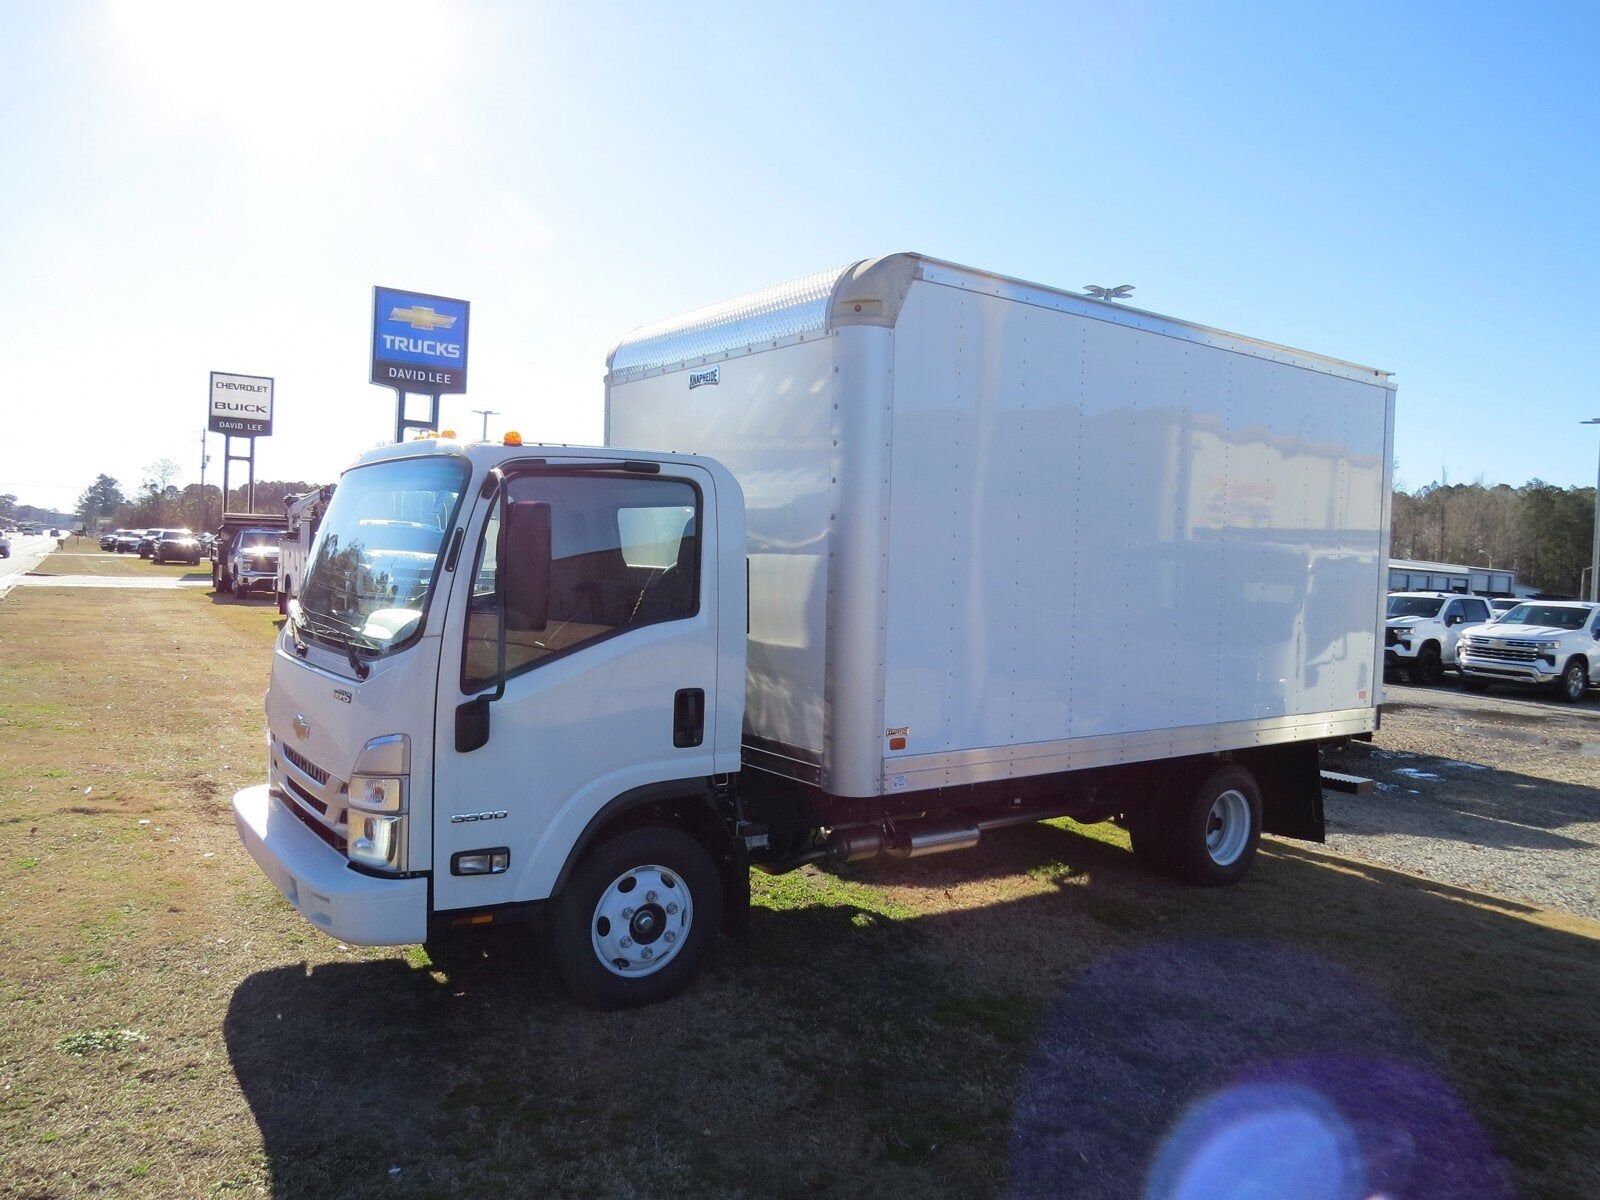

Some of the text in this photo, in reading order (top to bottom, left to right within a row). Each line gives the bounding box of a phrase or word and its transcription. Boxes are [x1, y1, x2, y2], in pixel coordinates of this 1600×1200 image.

[383, 334, 460, 359] TRUCKS
[388, 367, 452, 385] DAVID LEE
[215, 381, 268, 393] CHEVROLET
[214, 401, 268, 413] BUICK
[219, 421, 263, 431] DAVID LEE
